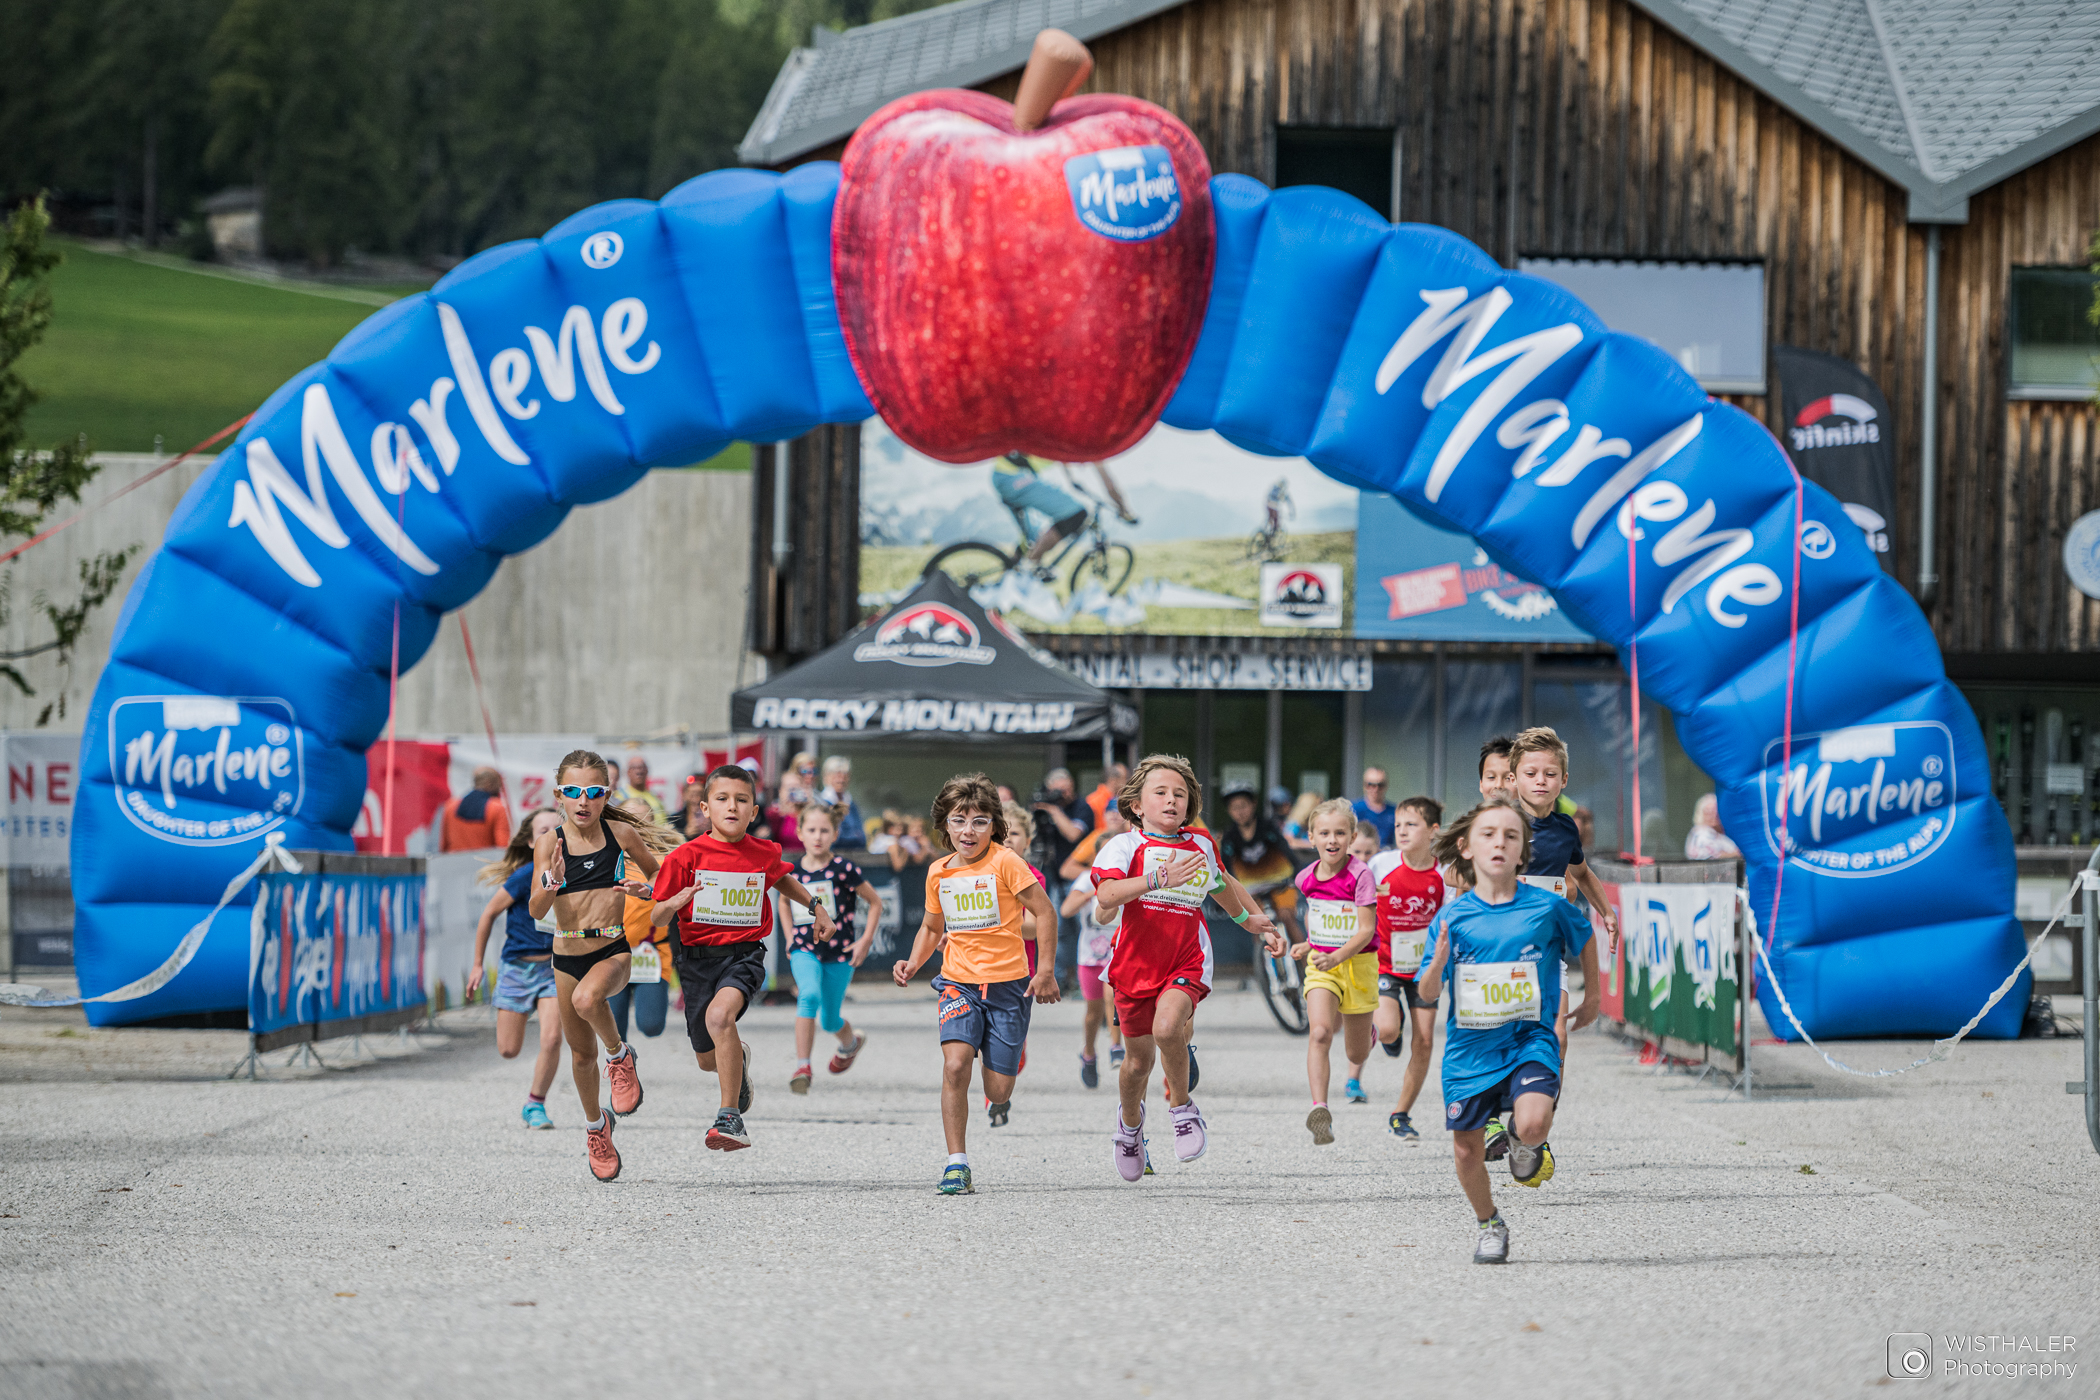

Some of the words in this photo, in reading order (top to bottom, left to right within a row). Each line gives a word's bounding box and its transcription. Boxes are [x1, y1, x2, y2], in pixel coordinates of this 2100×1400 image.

[228, 297, 661, 587] Marlene
[1375, 286, 1783, 628] Marlene
[1172, 654, 1243, 688] SHOP
[1268, 654, 1366, 689] SERVICE
[753, 698, 879, 730] ROCKY
[880, 699, 1076, 733] MOUNTAIN
[125, 727, 292, 809] Marlene
[1774, 758, 1944, 842] Marlene
[1850, 851, 1874, 869] OF
[720, 888, 761, 907] 10027
[954, 891, 993, 912] 10103
[695, 917, 759, 925] www.dreizinnenlauf.com
[696, 906, 711, 914] MINI
[1322, 914, 1357, 930] 10017
[1481, 981, 1534, 1005] 10049
[940, 997, 968, 1019] NDER
[940, 1004, 971, 1026] MOUR
